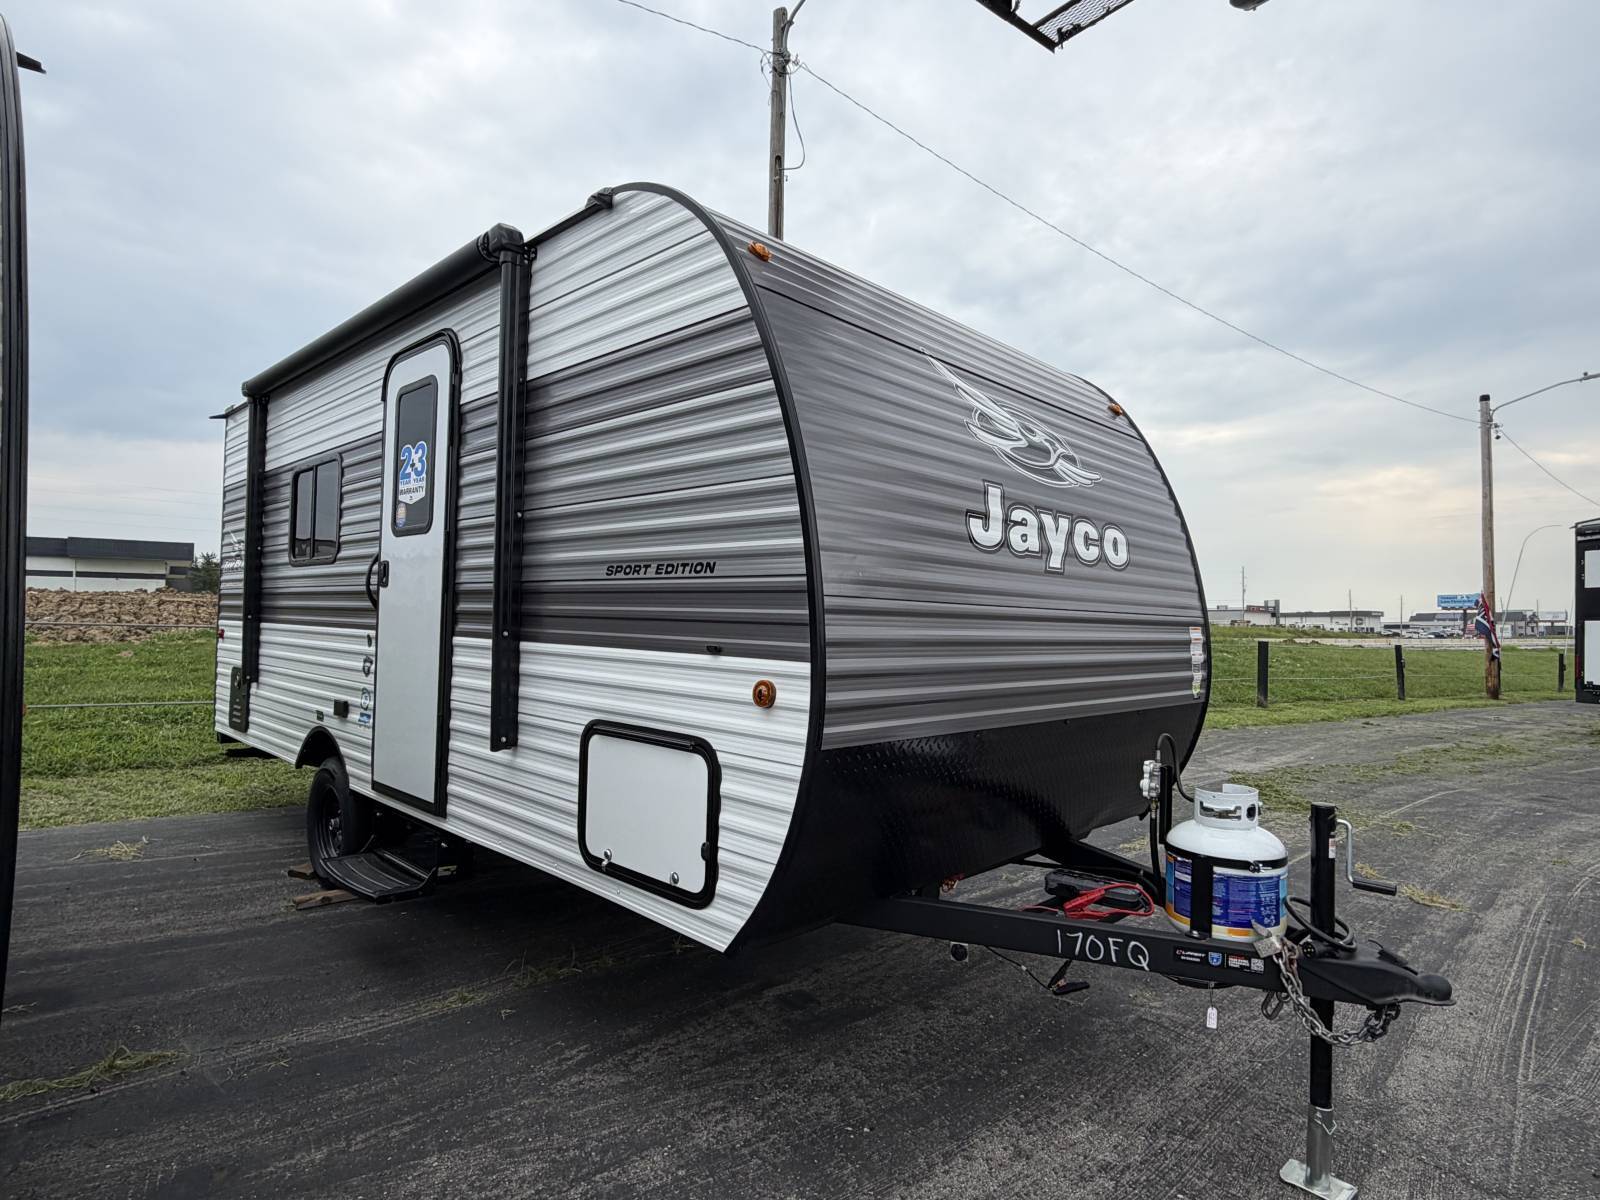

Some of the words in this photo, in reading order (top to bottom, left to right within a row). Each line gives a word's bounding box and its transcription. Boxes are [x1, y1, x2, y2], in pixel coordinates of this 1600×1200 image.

[400, 486, 424, 496] WARRANTY
[966, 481, 1130, 573] Jayco
[605, 564, 652, 576] SPORT
[655, 561, 716, 576] EDITION
[1056, 929, 1150, 972] 170FQ
